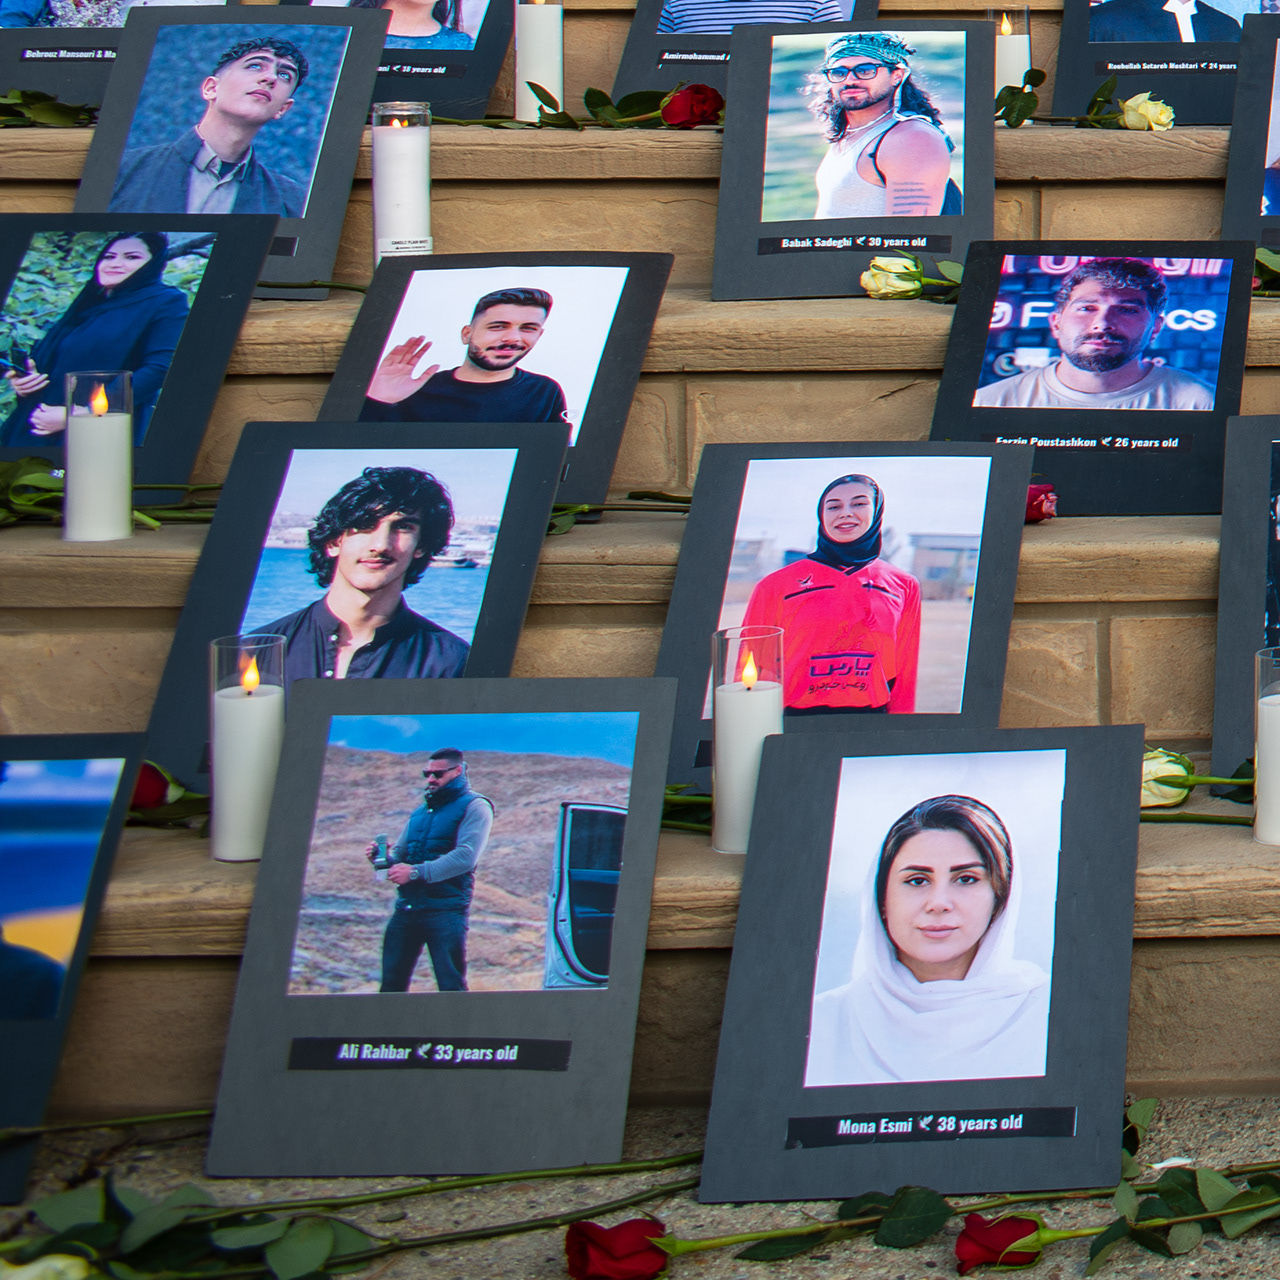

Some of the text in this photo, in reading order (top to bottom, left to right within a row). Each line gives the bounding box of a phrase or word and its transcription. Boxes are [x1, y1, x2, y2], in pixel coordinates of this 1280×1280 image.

[411, 66, 446, 74] years old
[781, 236, 927, 249] Babak Sadeghi 30 years old
[1030, 437, 1179, 449] Poustashkon 26 years old
[338, 1043, 519, 1063] Ali Rahbar 33 years old
[837, 1114, 1023, 1135] Mona Esmi 38 years old
